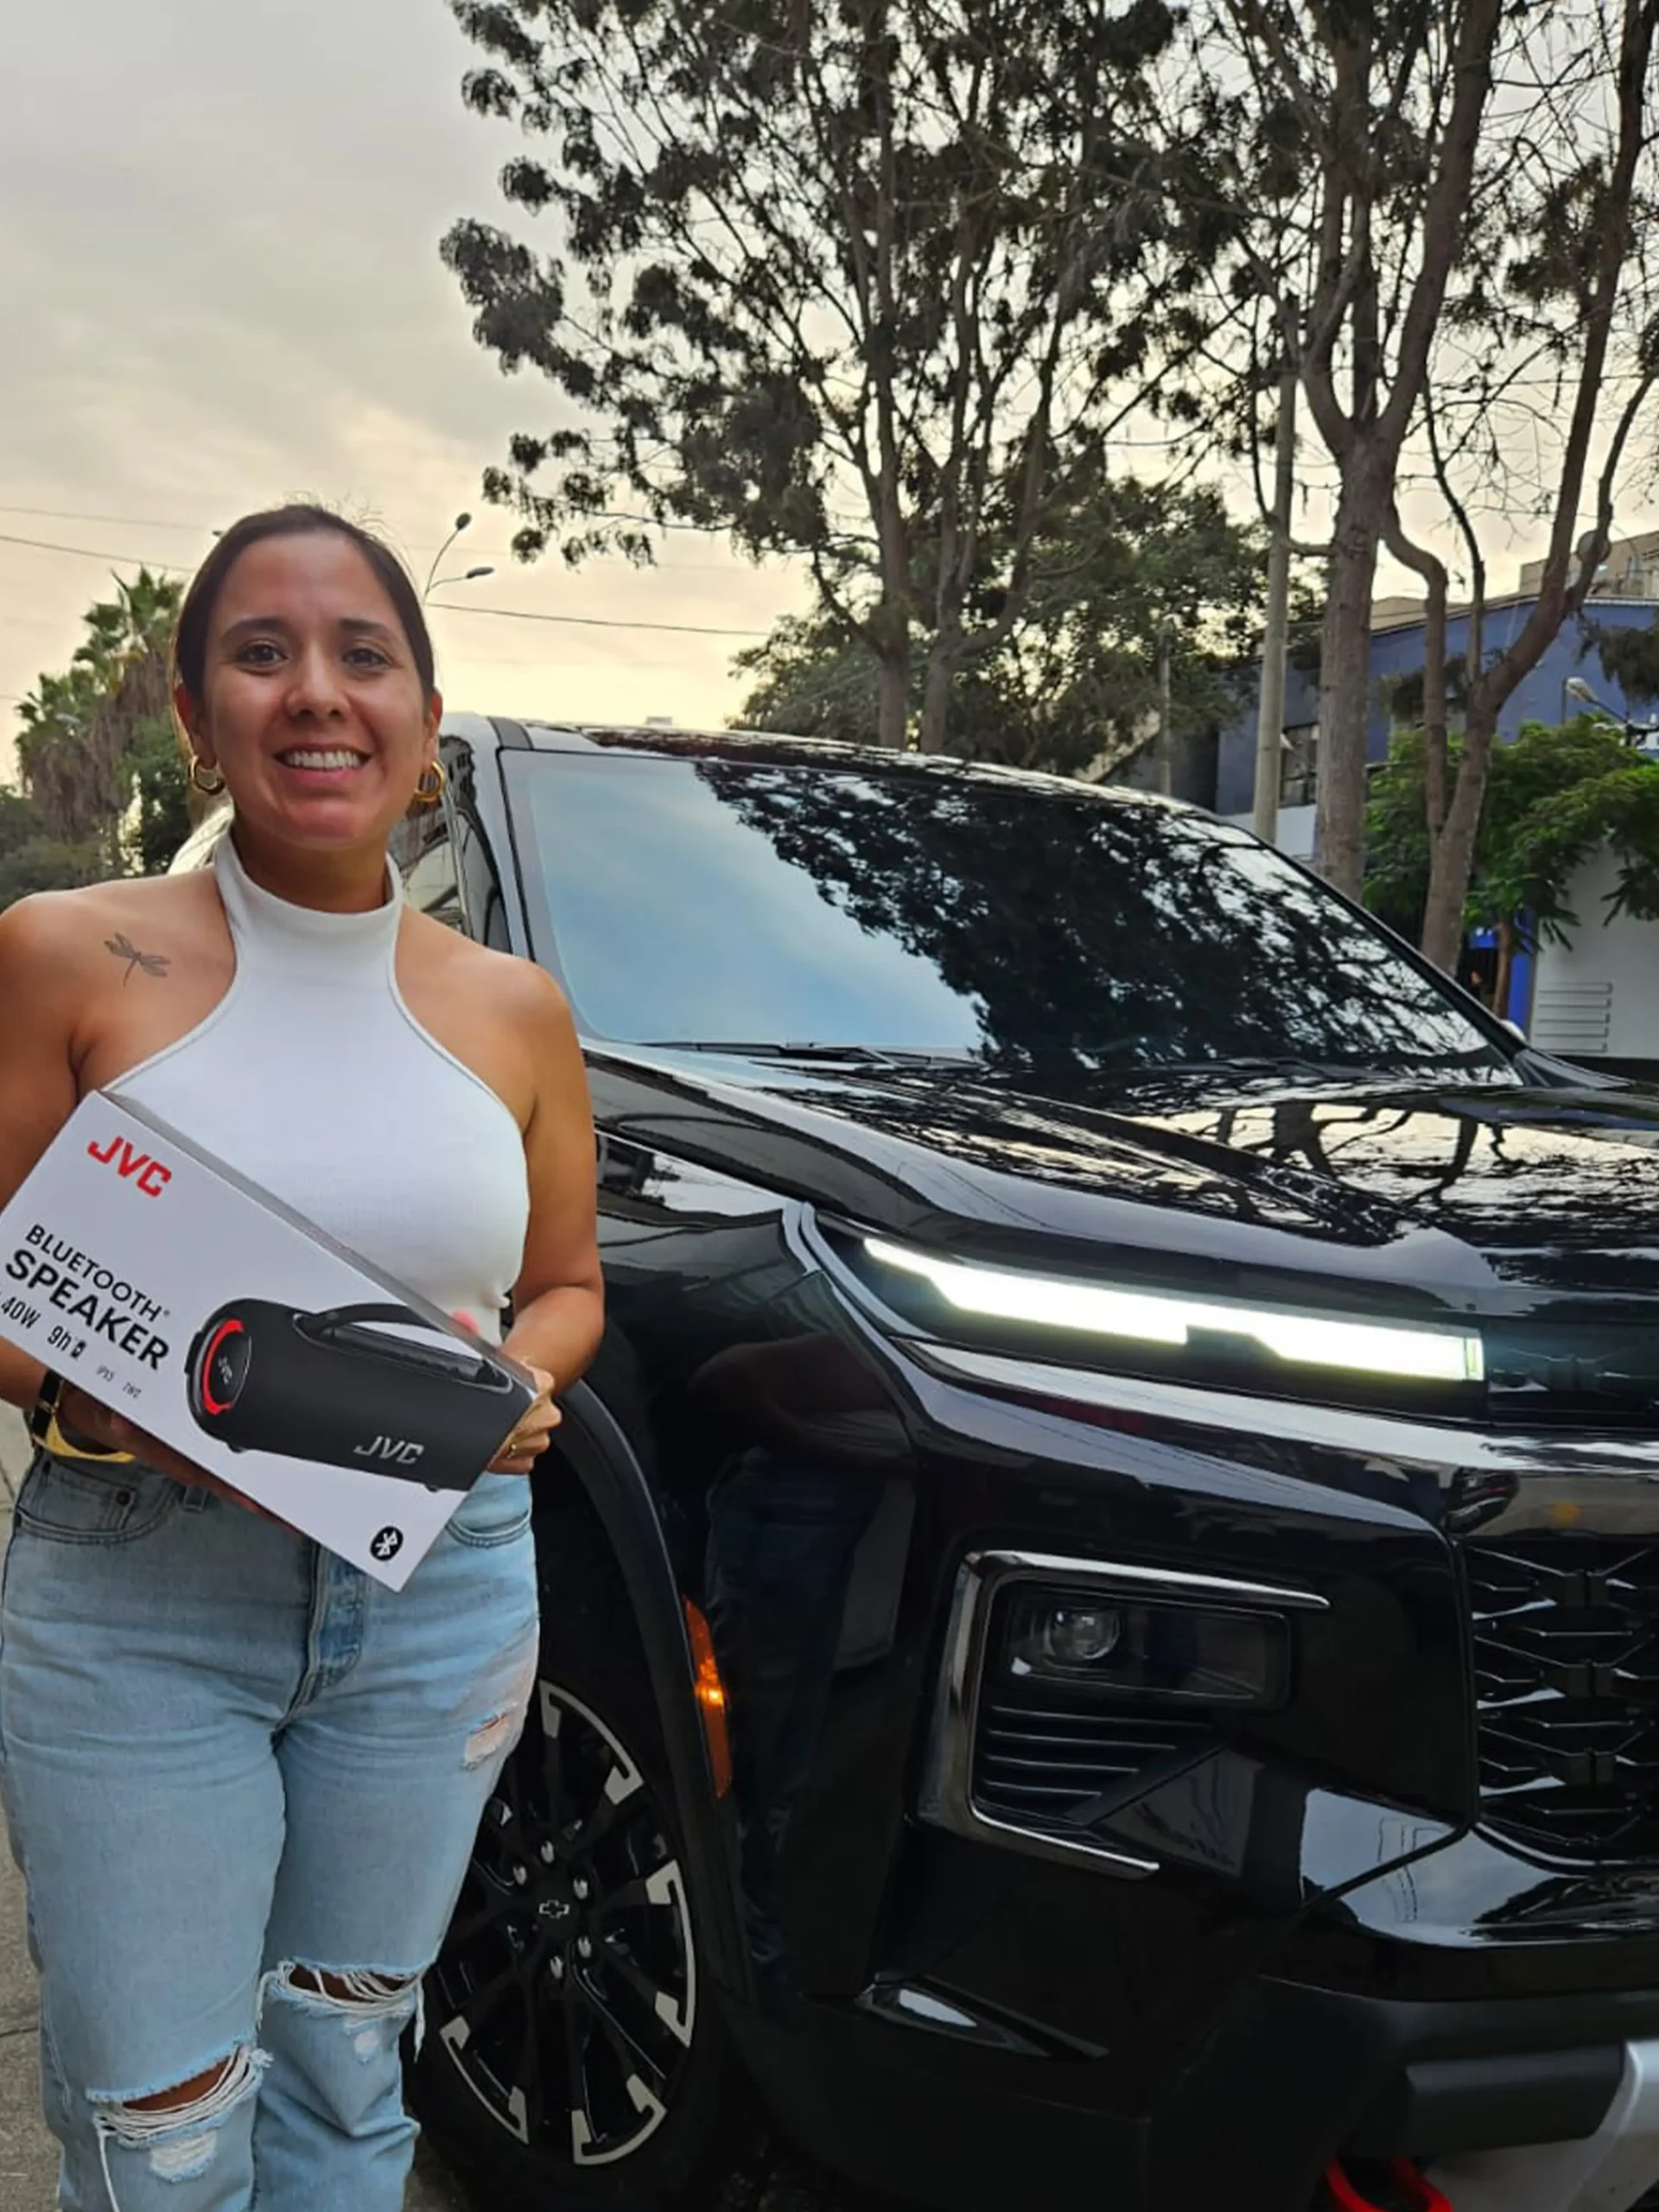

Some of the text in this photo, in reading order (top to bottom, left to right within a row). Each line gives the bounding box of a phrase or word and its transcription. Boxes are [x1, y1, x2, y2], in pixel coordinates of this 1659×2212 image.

[87, 1135, 172, 1197] JVC
[25, 1224, 162, 1322] BLUETOOTH
[1, 1297, 72, 1352] 40W 9h
[5, 1249, 169, 1370] SPEAKER
[353, 1435, 424, 1465] JVC
